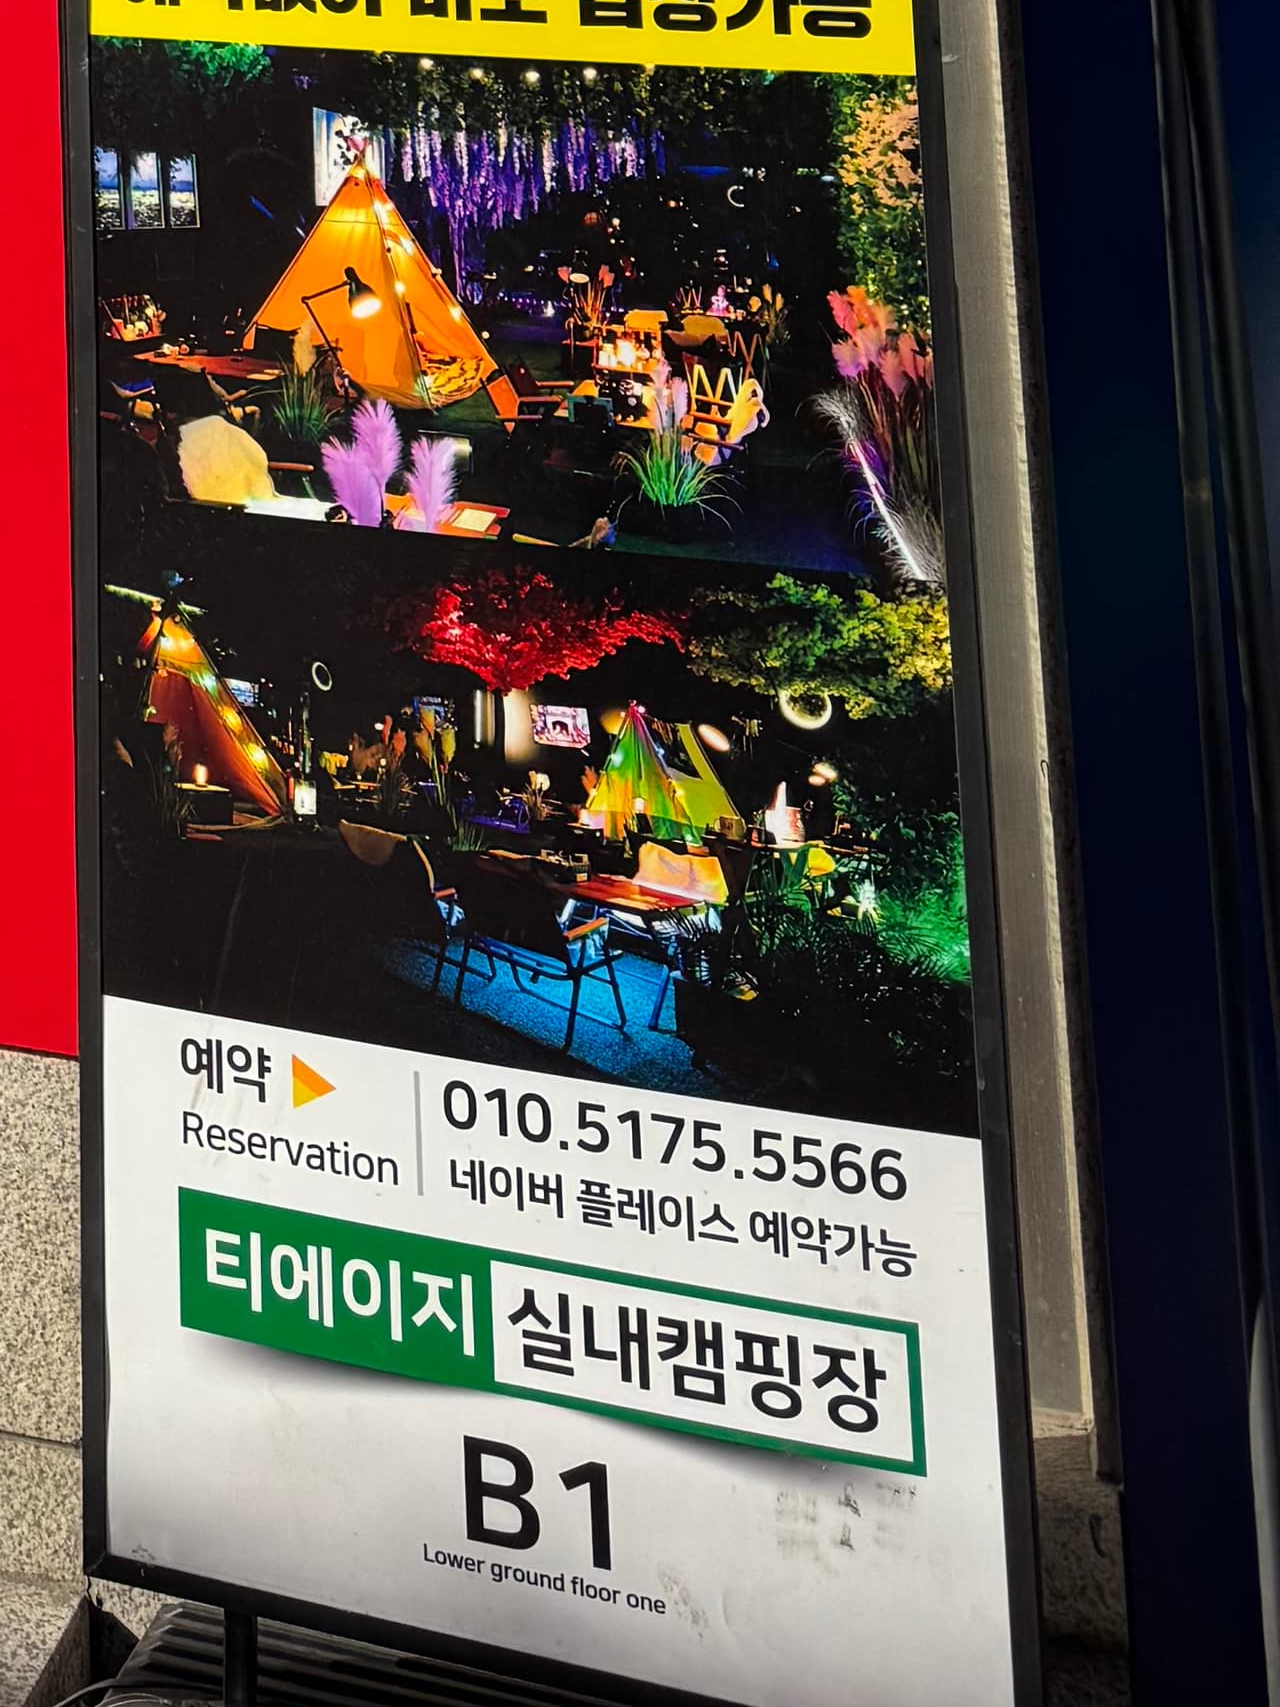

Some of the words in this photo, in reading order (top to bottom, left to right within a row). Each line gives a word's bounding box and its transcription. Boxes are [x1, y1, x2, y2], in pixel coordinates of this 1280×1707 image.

[179, 1036, 272, 1104] 예약
[180, 1111, 400, 1186] Reservation
[443, 1080, 908, 1200] 010.5175.5566
[450, 1159, 564, 1218] 네이버
[576, 1178, 740, 1244] 플레이스
[749, 1209, 917, 1278] 예약가능
[204, 1228, 475, 1358] 티에이지
[506, 1286, 888, 1434] 실내캠핑장
[462, 1435, 612, 1571] B1
[422, 1543, 485, 1575] Lower
[491, 1561, 565, 1592] ground
[570, 1576, 619, 1605] floor
[626, 1592, 666, 1615] one
